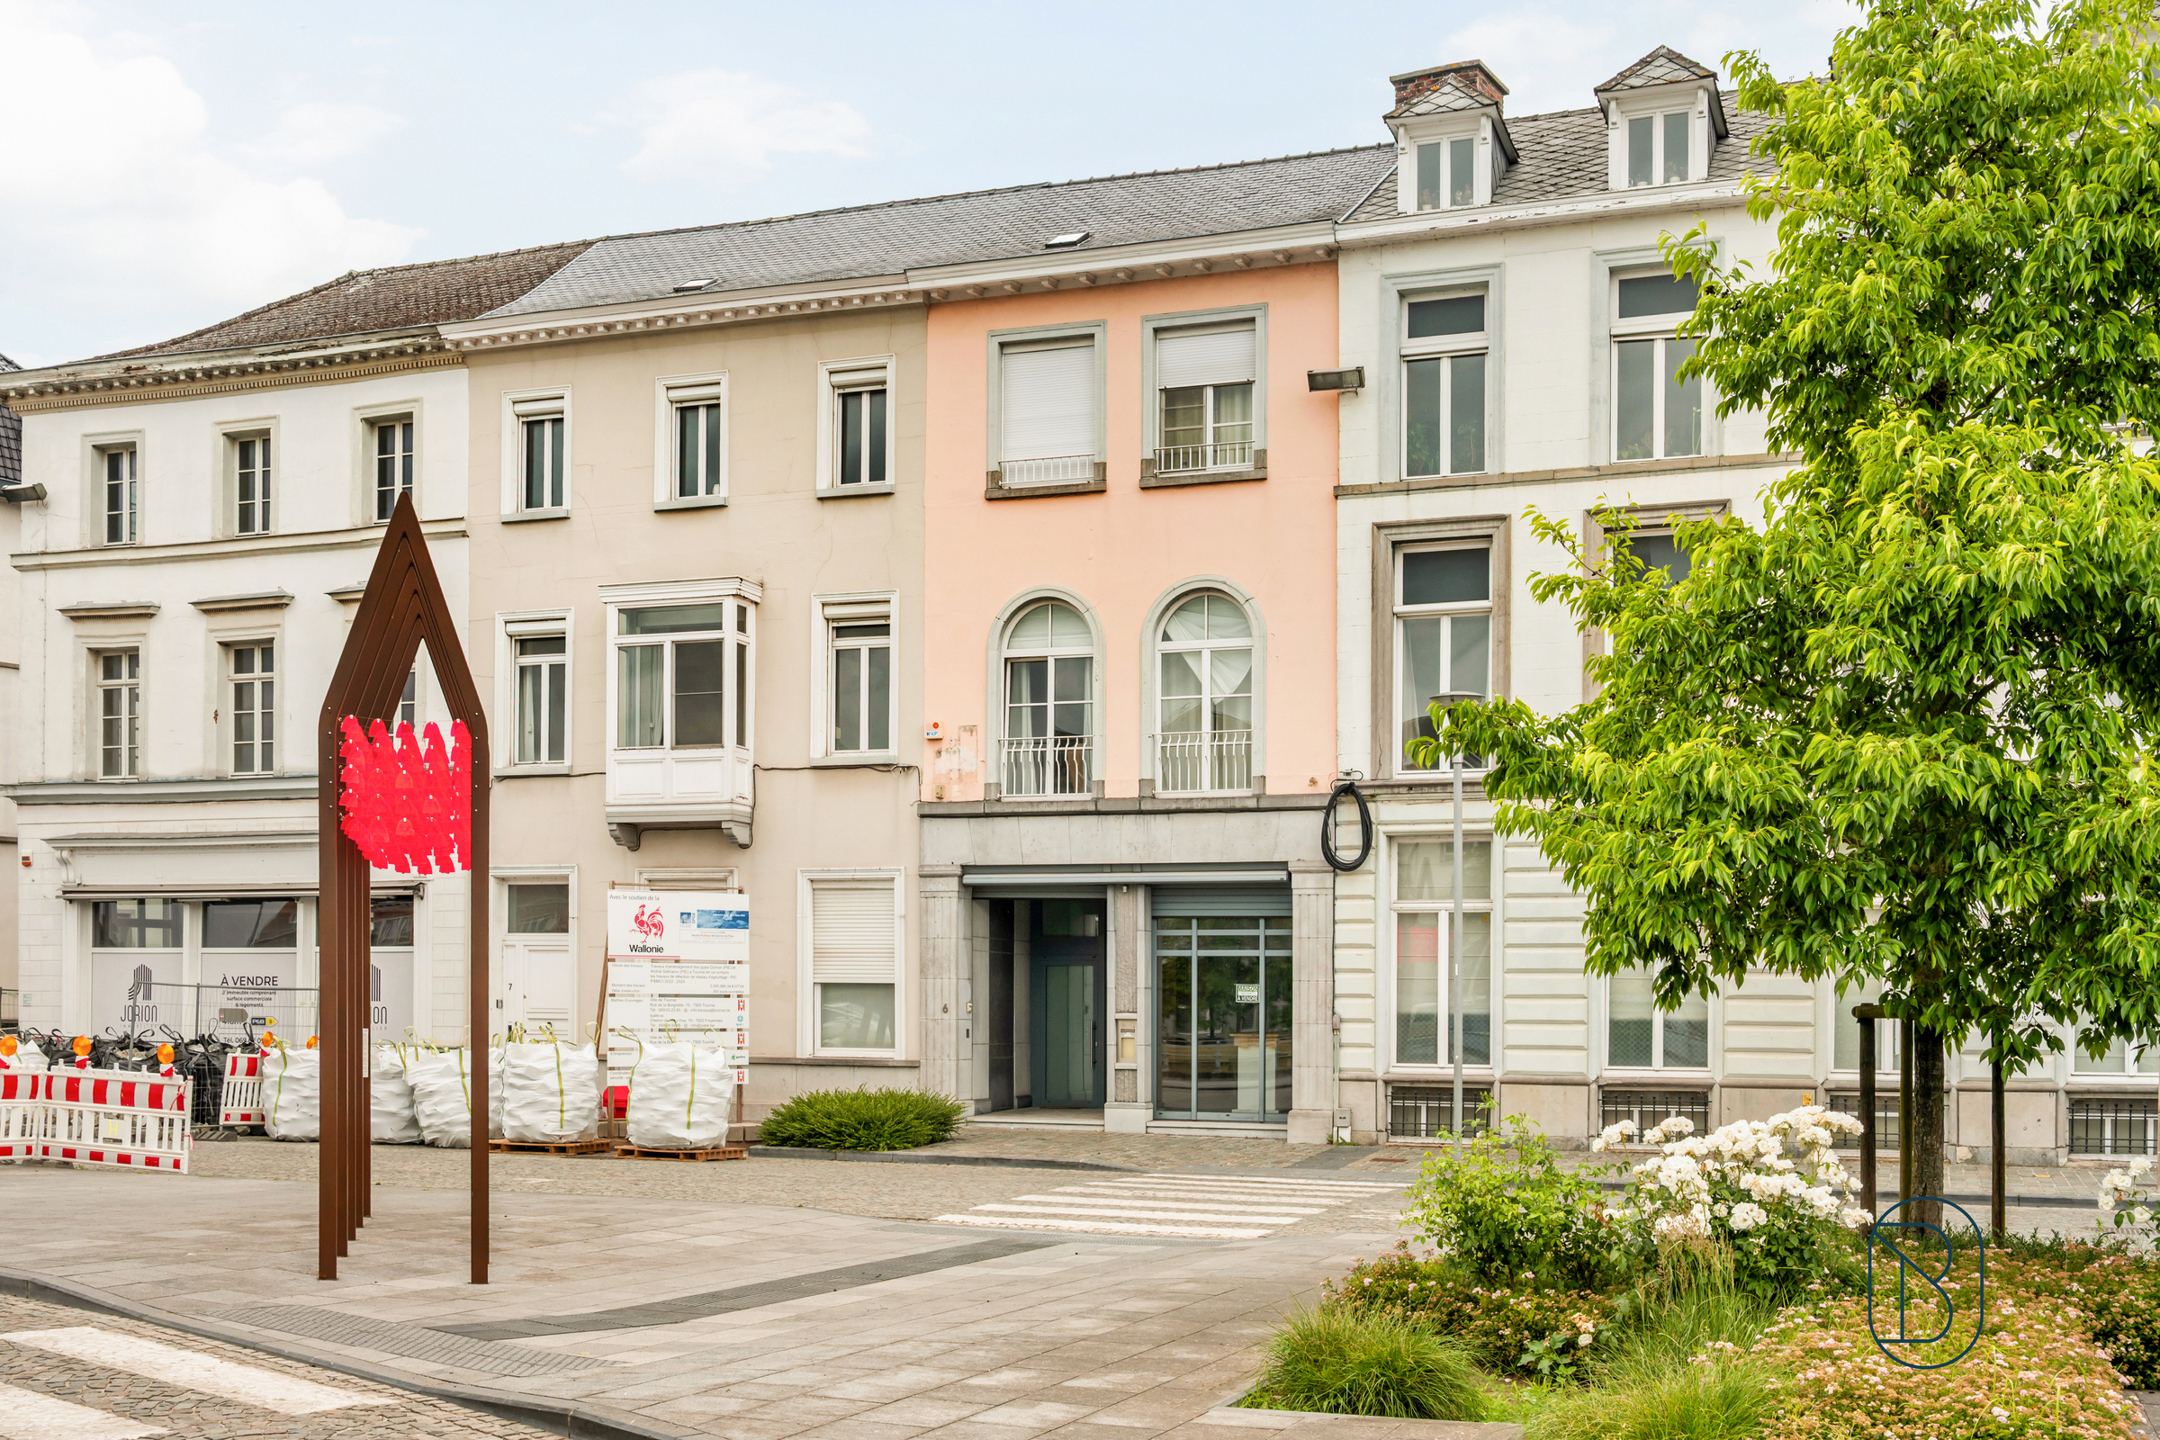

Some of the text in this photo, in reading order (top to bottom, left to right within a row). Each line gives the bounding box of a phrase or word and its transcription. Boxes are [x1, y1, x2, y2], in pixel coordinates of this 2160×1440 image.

[629, 944, 664, 953] Wallonie
[221, 974, 278, 986] À VENDRE
[120, 1005, 157, 1022] JORION
[942, 1003, 948, 1014] 6
